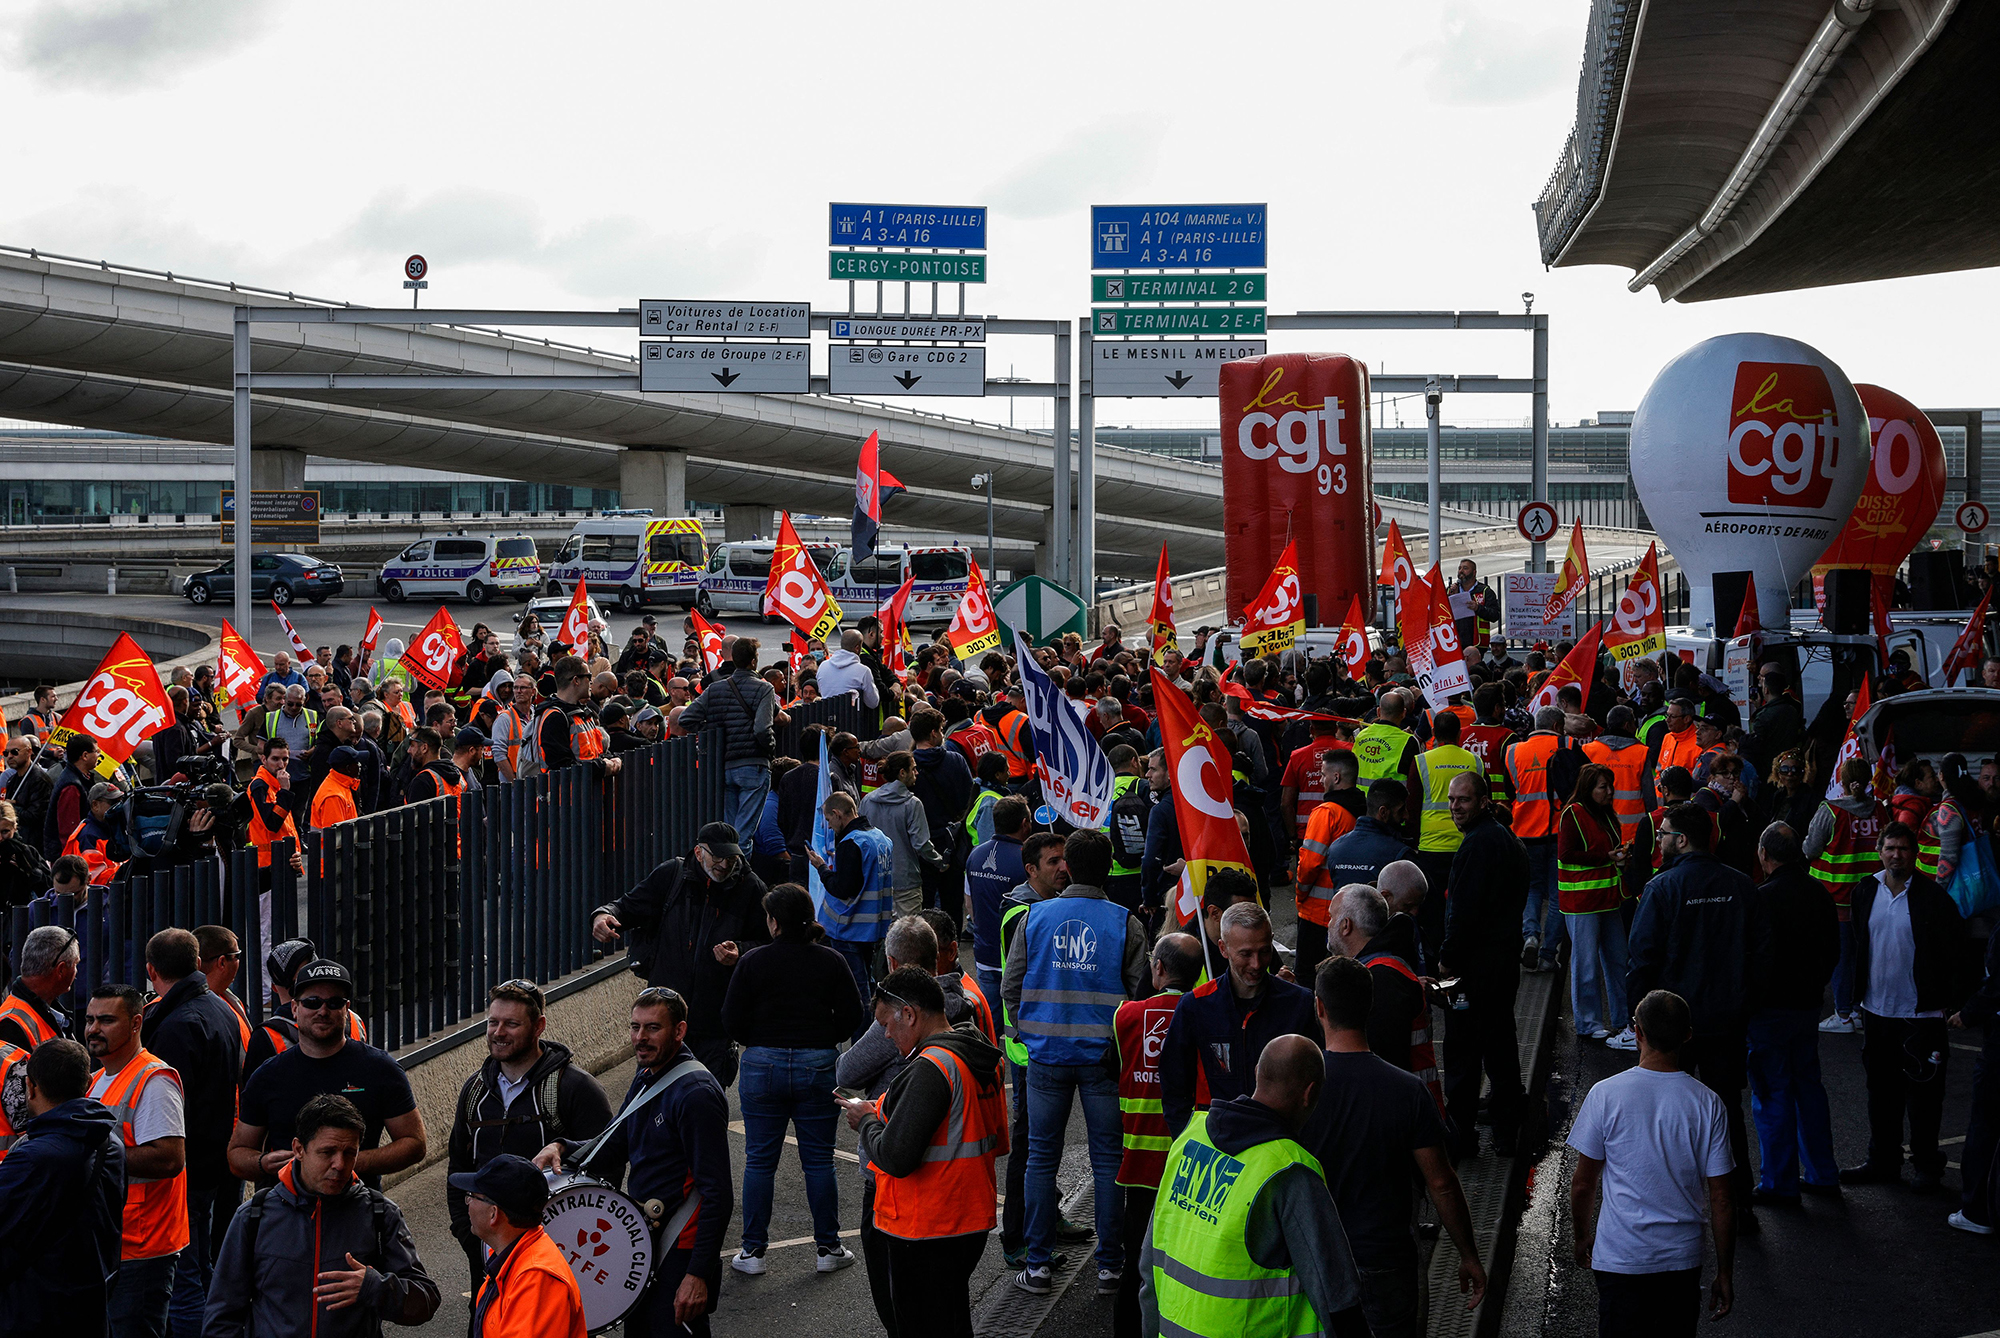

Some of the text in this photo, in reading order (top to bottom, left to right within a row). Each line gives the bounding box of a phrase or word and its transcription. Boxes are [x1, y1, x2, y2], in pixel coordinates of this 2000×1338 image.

[861, 210, 982, 228] A 1 (PARIS-LILLE)
[1140, 212, 1262, 226] A 104 (MARNE LA V.)
[861, 227, 931, 243] A 3-A 16
[1140, 230, 1262, 245] A 1 (PARIS-LILLE)
[1140, 248, 1213, 263] A 3-A 16
[409, 262, 423, 273] 50
[836, 258, 980, 276] CERGY-PONTOISE
[1131, 281, 1255, 295] TERMINAL 2 G
[667, 305, 805, 318] Voitures de Location
[666, 320, 780, 333] Car Rental (2 E-F)
[1124, 313, 1263, 328] TERMINAL 2 E-F
[854, 325, 897, 336] LONGUE
[901, 325, 937, 336] DURÉE
[940, 325, 982, 337] PR-PX
[666, 347, 806, 362] Cars de Groupe (2 E-F)
[887, 351, 920, 363] Gare
[927, 351, 956, 363] CDG
[959, 352, 968, 363] 2
[1102, 347, 1257, 360] LE MESNIL AMELOT
[1238, 396, 1347, 474] cgt
[1728, 409, 1840, 496] cgt
[1317, 463, 1348, 496] 93
[1857, 495, 1902, 509] OISSY
[1866, 509, 1895, 523] CDG
[1704, 521, 1830, 541] AÉROPORTS DE PARIS
[417, 568, 455, 578] POLICE
[583, 570, 609, 580] POLICE
[722, 580, 751, 591] POLICE
[842, 588, 875, 599] POLICE
[426, 677, 437, 688] DE
[78, 672, 166, 746] cgt
[1358, 737, 1392, 752] ORGANISATION
[1365, 744, 1381, 756] cgt
[1461, 740, 1489, 757] cgt
[1117, 813, 1145, 854] NIKE
[1851, 817, 1878, 836] cgt
[983, 871, 1011, 883] AÉROPORT
[307, 966, 341, 978] VANS
[1052, 961, 1097, 971] TRANSPORT
[1133, 1071, 1160, 1083] ROIS
[1169, 1185, 1218, 1226] Aérien
[542, 1193, 646, 1292] ENTRALE SOCIAL CLUB
